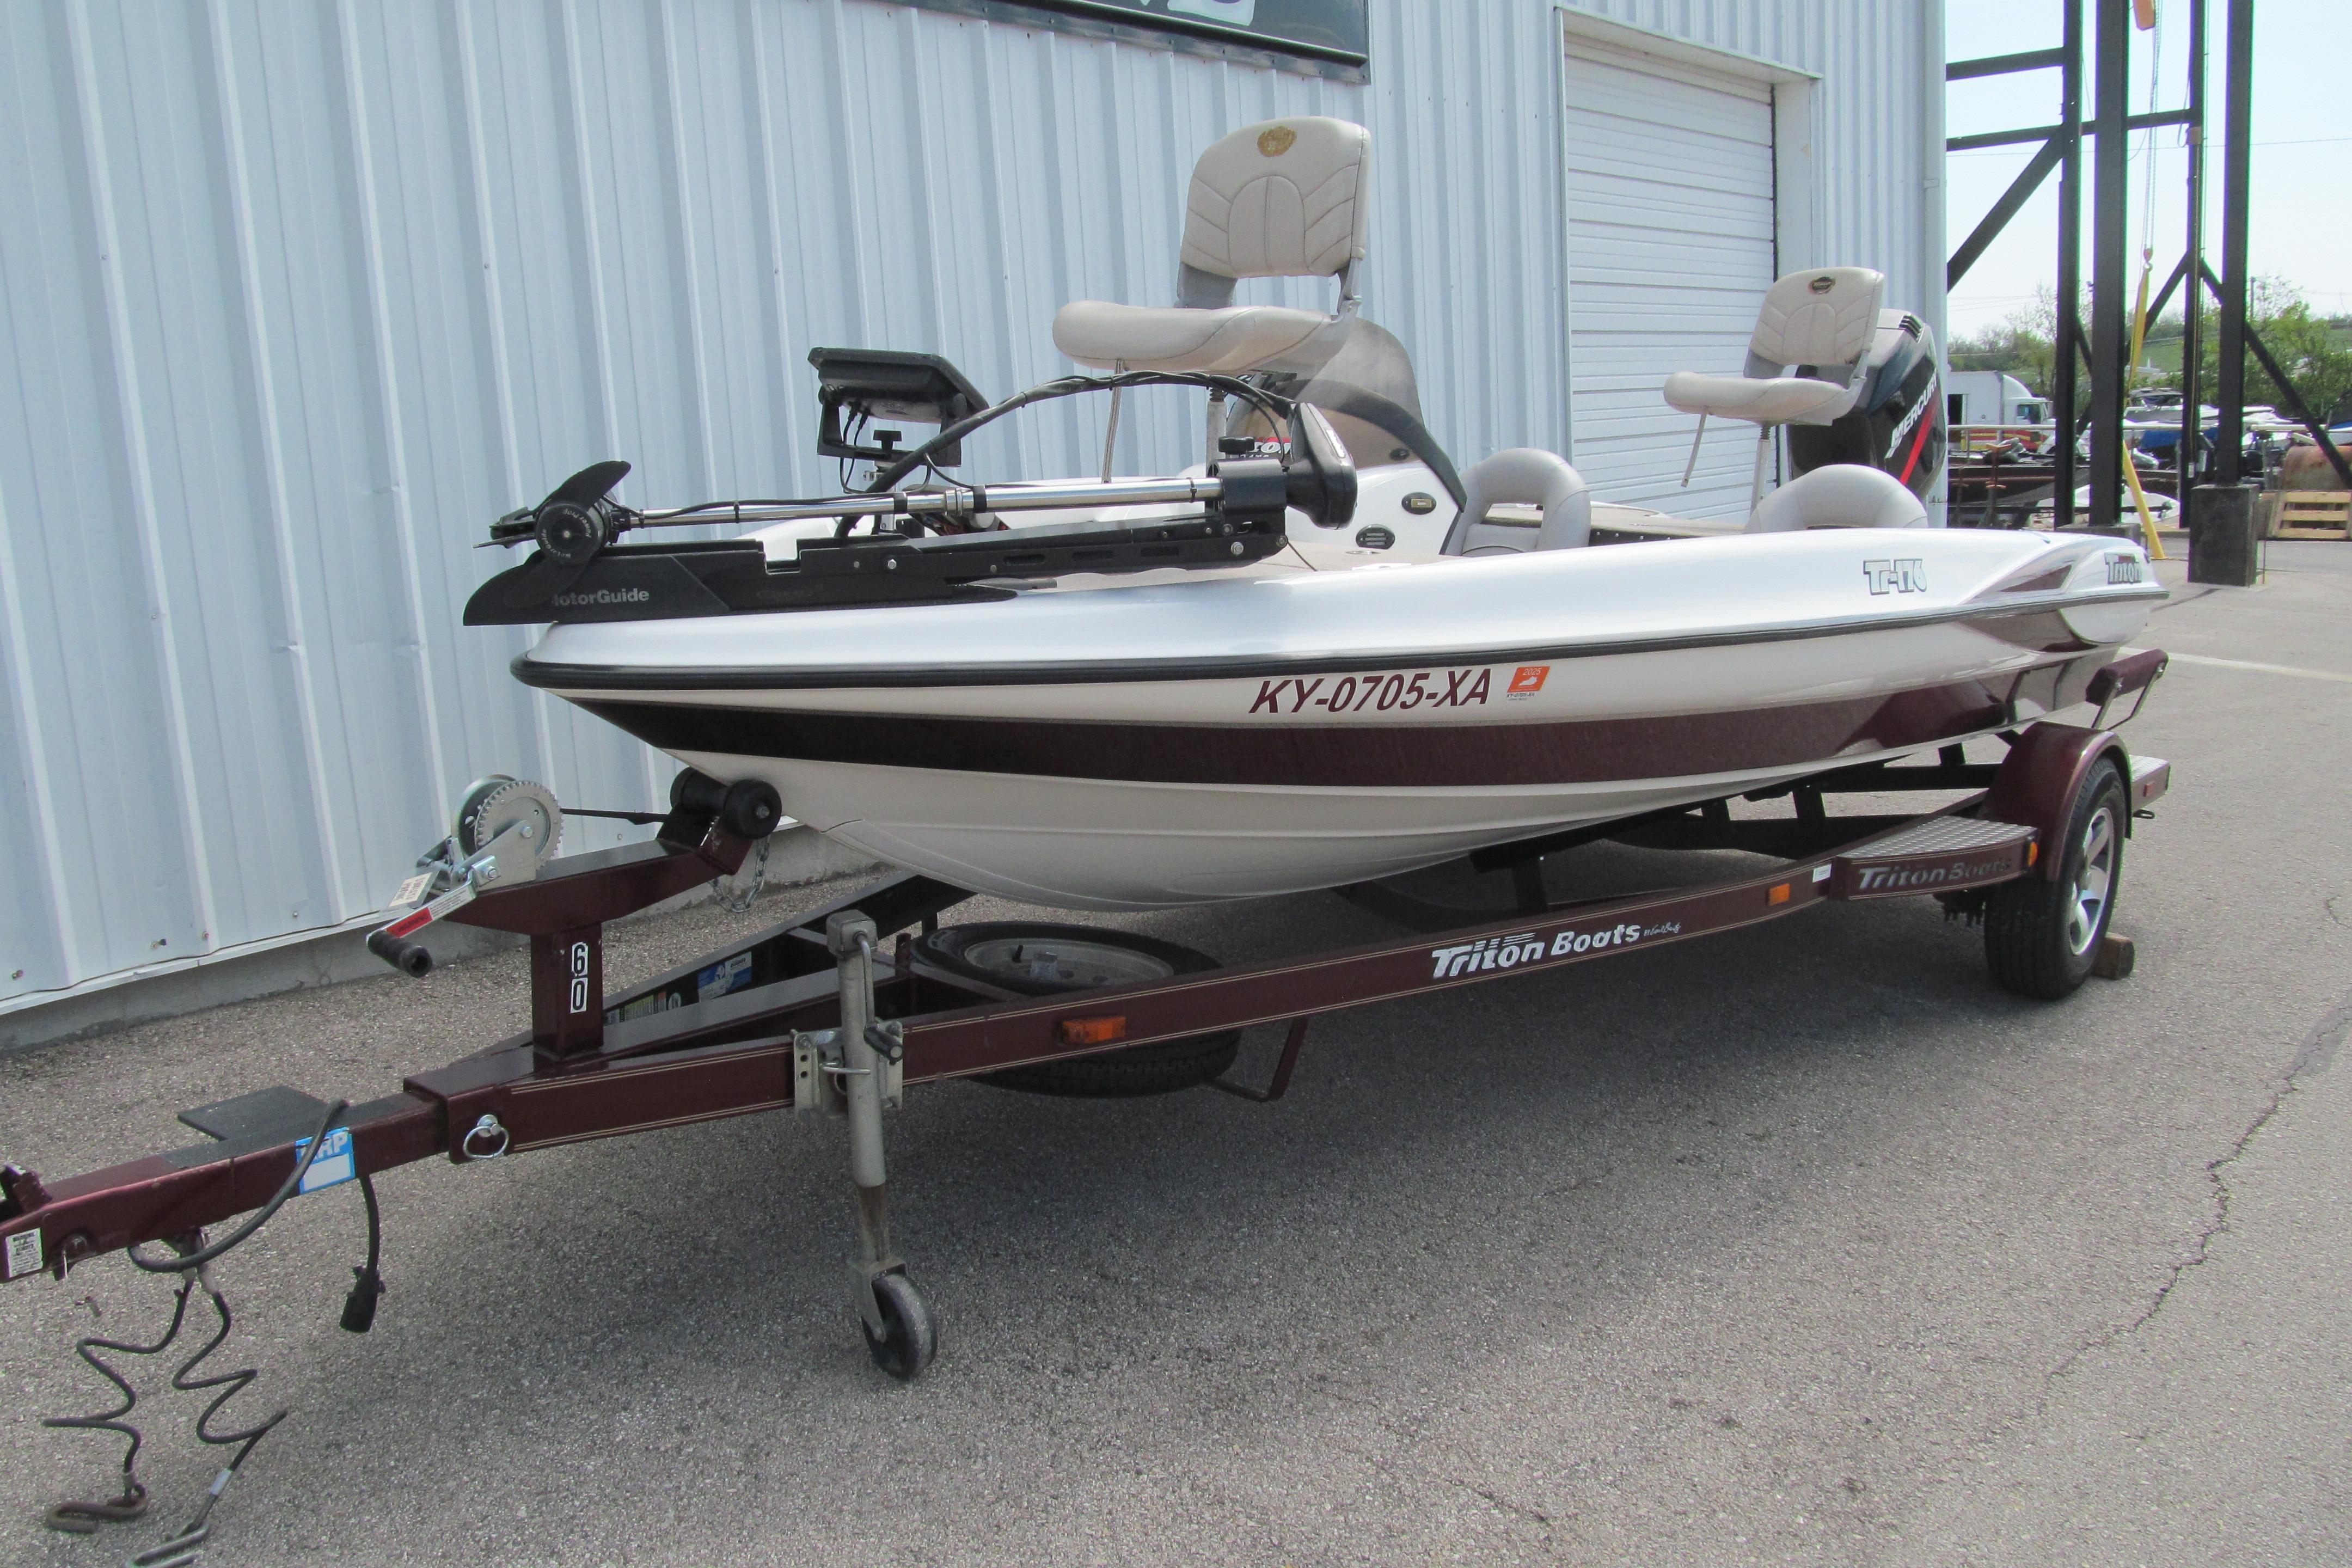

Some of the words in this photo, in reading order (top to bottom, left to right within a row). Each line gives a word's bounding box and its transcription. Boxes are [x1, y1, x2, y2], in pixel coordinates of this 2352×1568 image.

[1522, 667, 1542, 676] 2025
[1248, 668, 1491, 714] KY-0705-XA
[1859, 865, 1946, 890] Triton
[1432, 933, 1545, 979] Triton
[1550, 924, 1641, 957] Boats
